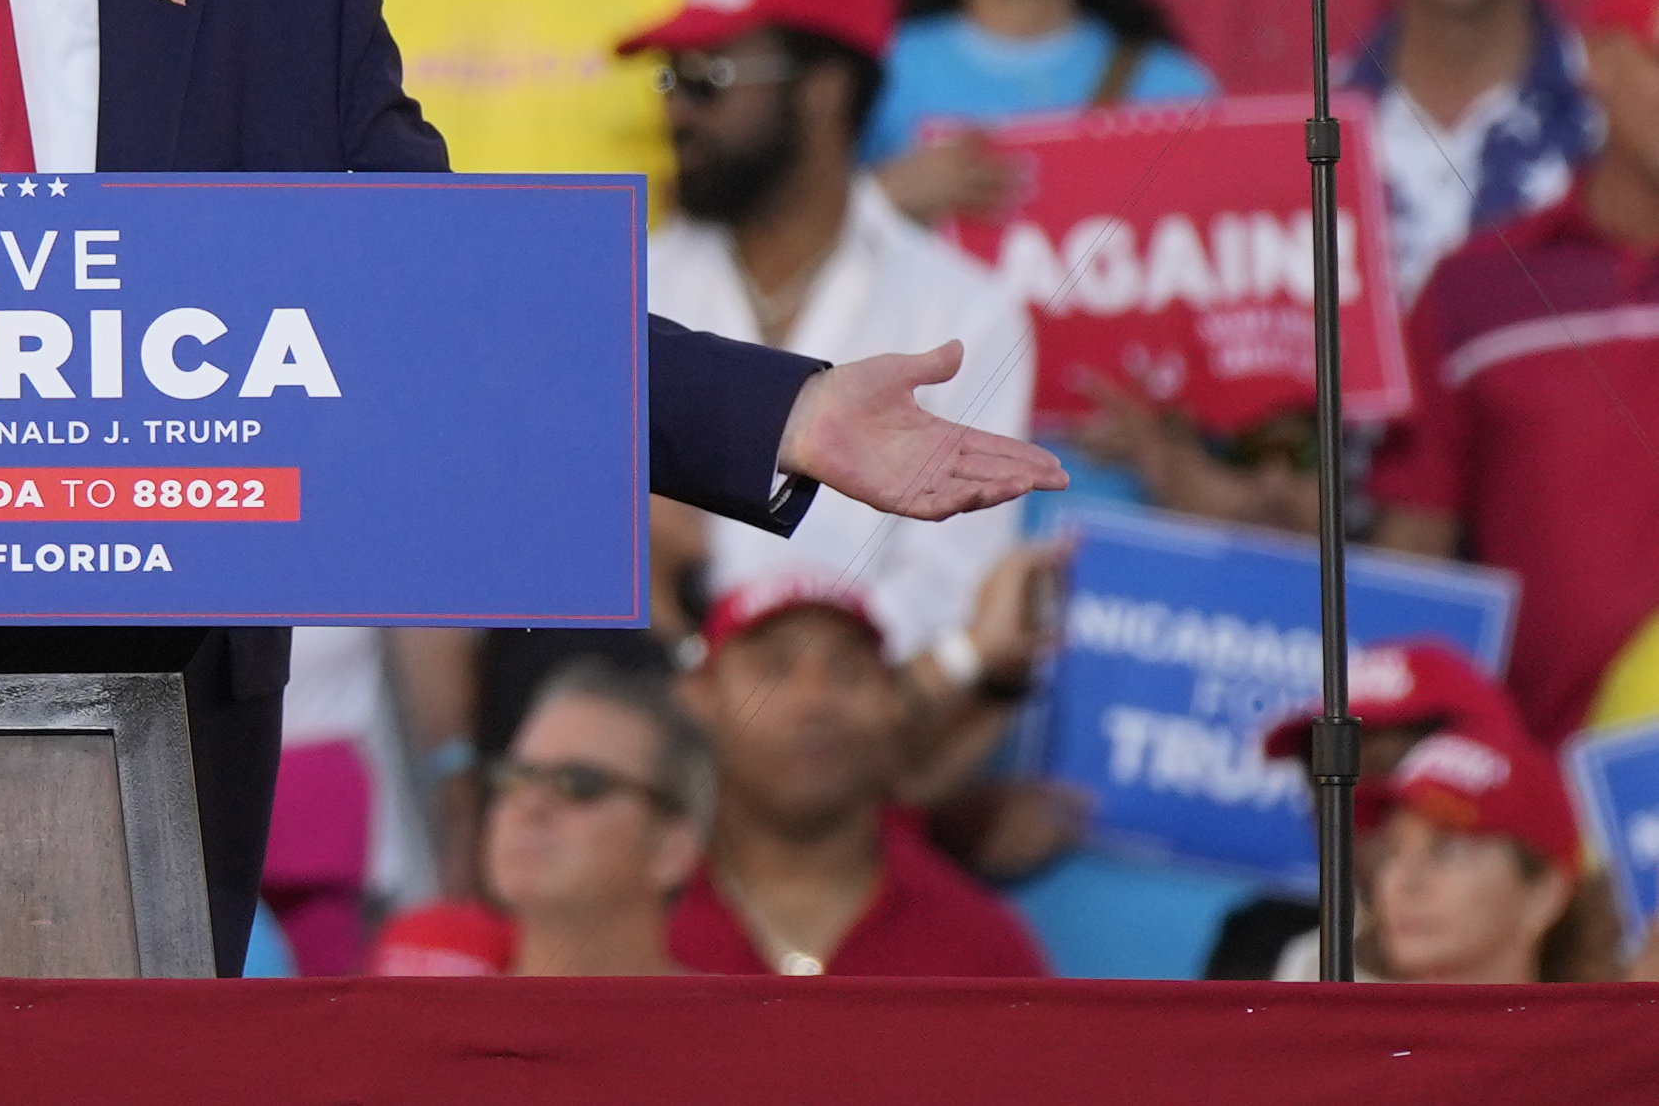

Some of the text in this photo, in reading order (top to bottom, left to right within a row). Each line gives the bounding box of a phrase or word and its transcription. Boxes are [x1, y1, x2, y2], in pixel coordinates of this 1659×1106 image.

[103, 420, 130, 444] J.
[143, 419, 262, 444] TRUMP
[61, 479, 116, 508] TO
[132, 479, 265, 508] 88022
